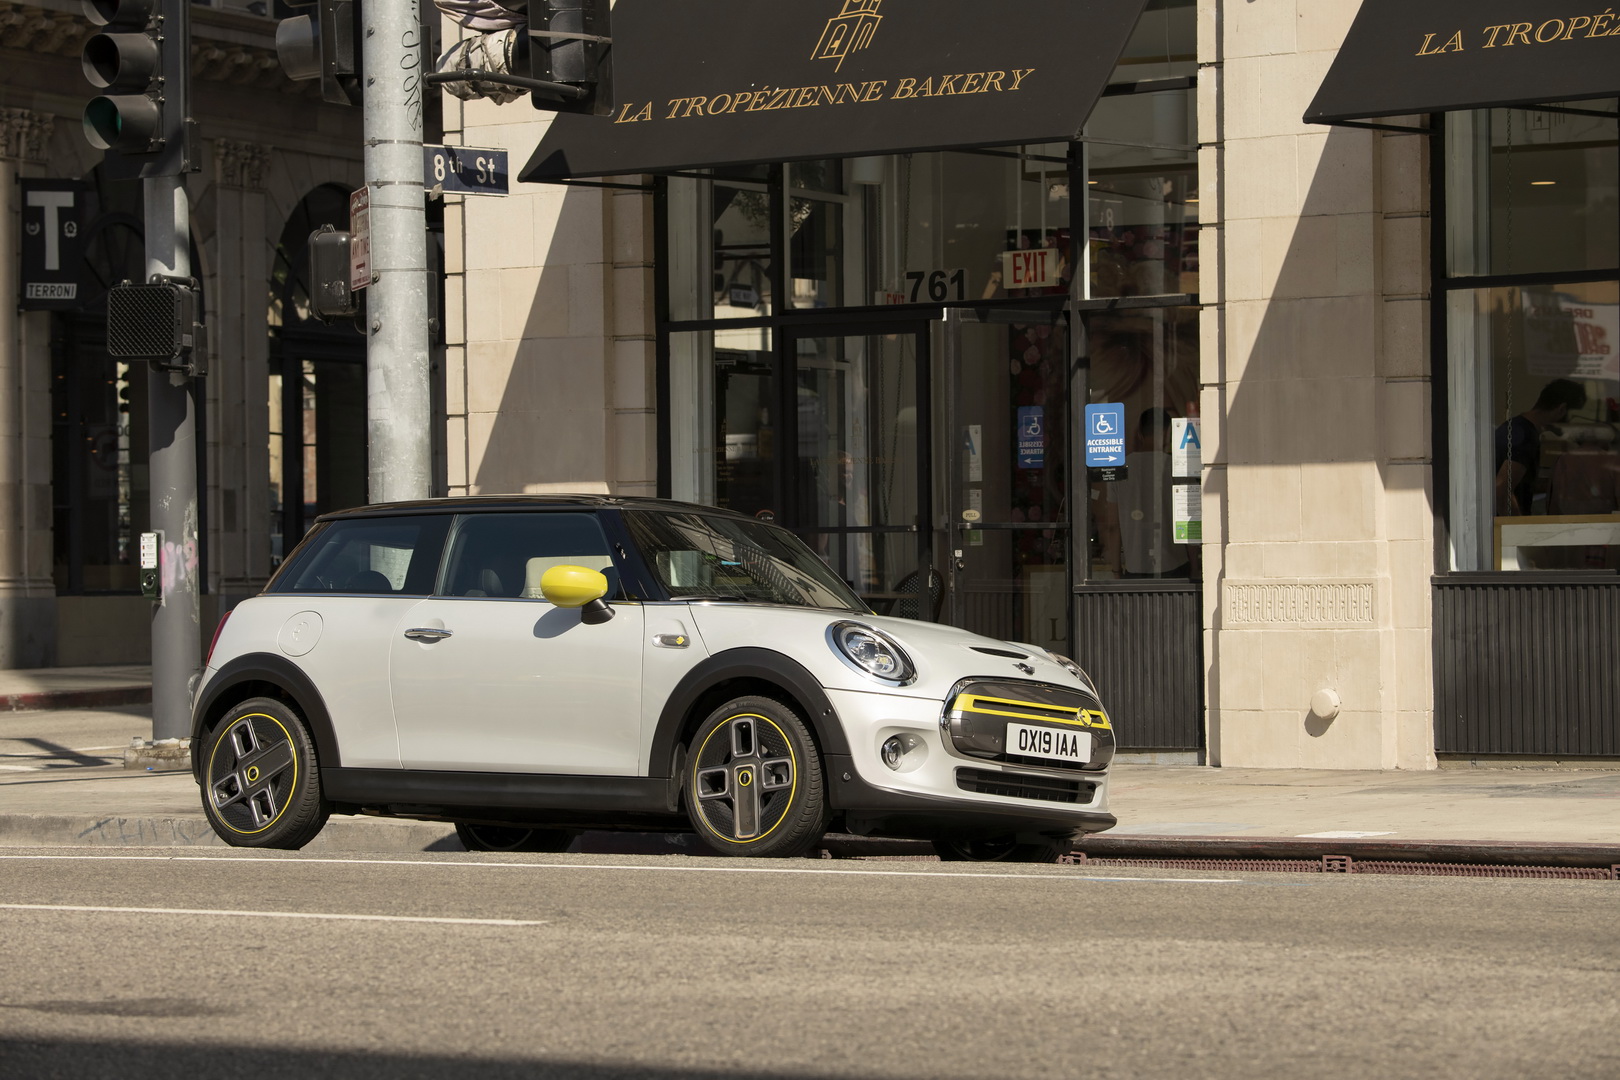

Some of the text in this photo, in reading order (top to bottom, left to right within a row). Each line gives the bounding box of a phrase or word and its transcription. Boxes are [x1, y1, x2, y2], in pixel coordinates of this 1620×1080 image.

[1415, 30, 1464, 56] LA
[614, 68, 1036, 123] LA TROPÉZIENNE BAKERY
[434, 154, 496, 184] 8th St
[1012, 251, 1047, 284] EXIT
[28, 284, 75, 298] TERRONI
[906, 269, 965, 302] 761
[1089, 446, 1122, 454] ENTRANCE
[1179, 422, 1201, 449] A
[1019, 728, 1078, 757] OX19 IAA
